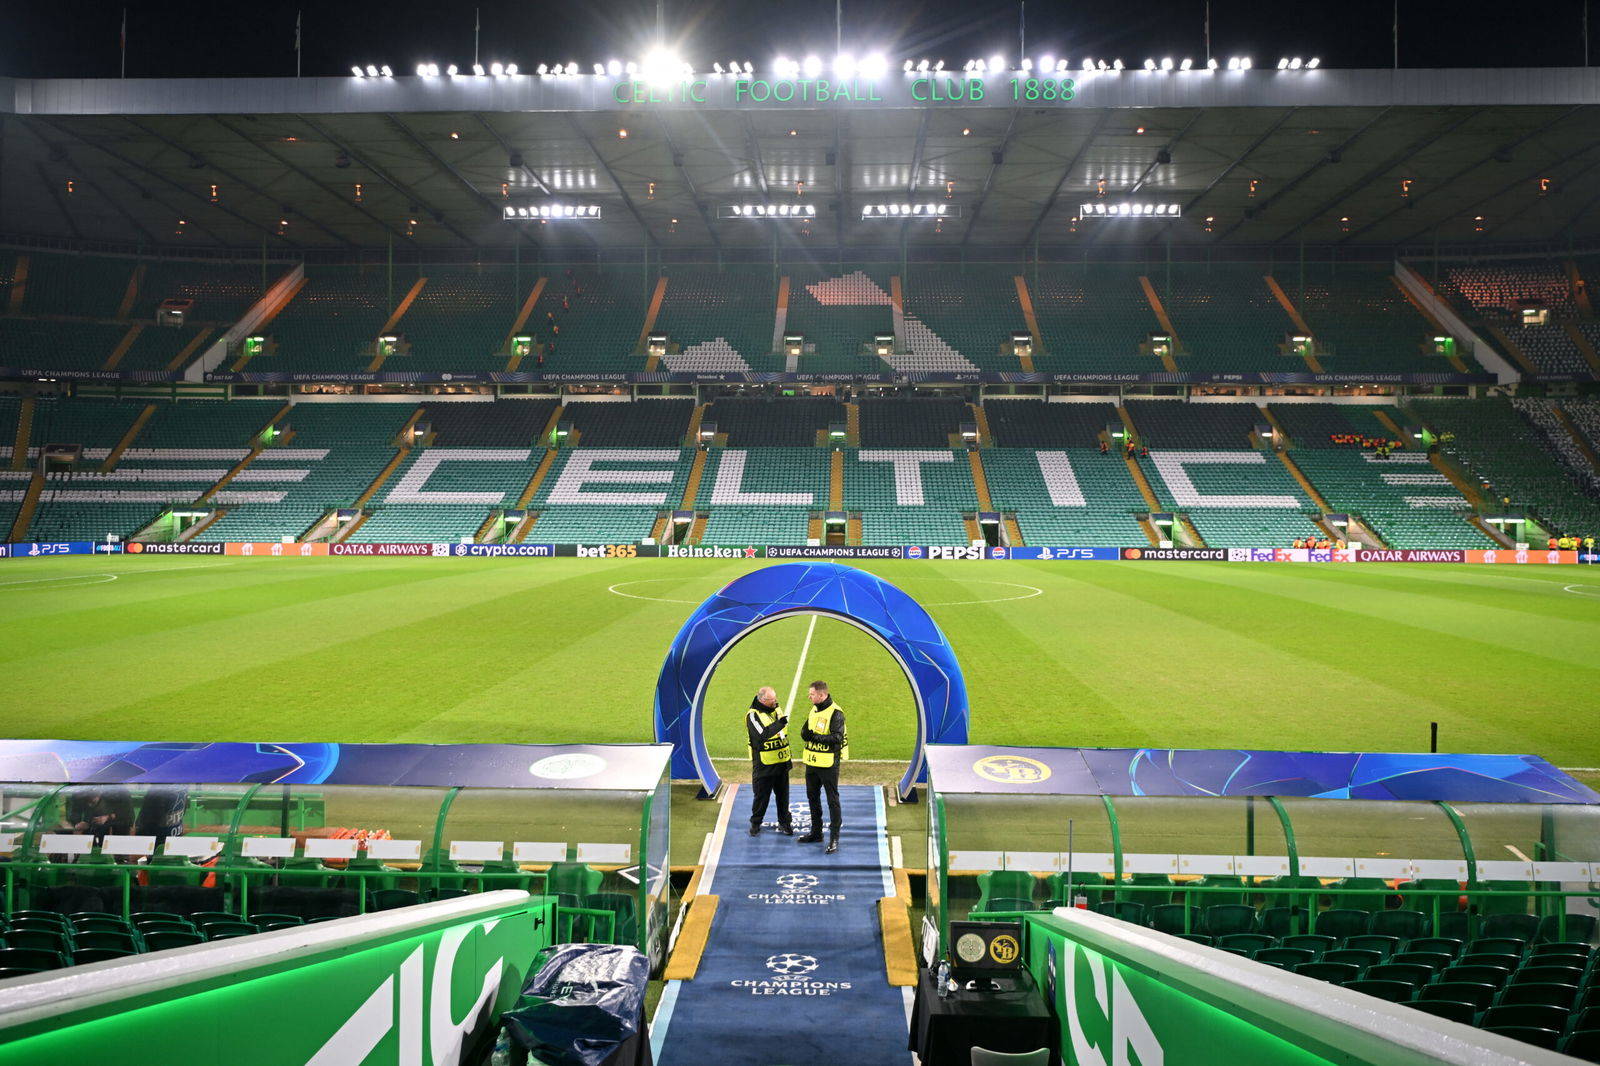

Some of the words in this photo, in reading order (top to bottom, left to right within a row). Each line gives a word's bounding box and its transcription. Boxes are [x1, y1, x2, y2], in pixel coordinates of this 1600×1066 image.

[612, 80, 707, 104] CELTIC
[735, 79, 882, 102] FOOTBALL
[911, 77, 985, 101] CLUB
[1009, 77, 1075, 101] 1888
[42, 544, 70, 553] PS5
[146, 543, 221, 553] mastercard
[334, 544, 373, 555] QATAR
[378, 544, 428, 555] AIRWAYS
[470, 544, 548, 557] crypto.com
[576, 544, 637, 558] bet365
[667, 545, 743, 558] Heineken
[802, 549, 854, 557] CHAMPIONS
[857, 549, 890, 557] LEAGUE
[928, 546, 986, 560] PEPSI
[1057, 549, 1094, 558] PS5
[1144, 549, 1224, 559] mastercard
[1251, 549, 1292, 562] FedEx
[1308, 549, 1349, 562] FedEx
[1360, 551, 1401, 562] QATAR
[1407, 551, 1461, 562] AIRWAYS
[731, 980, 852, 990] CHAMPIONS
[751, 987, 831, 996] LEAGUE
